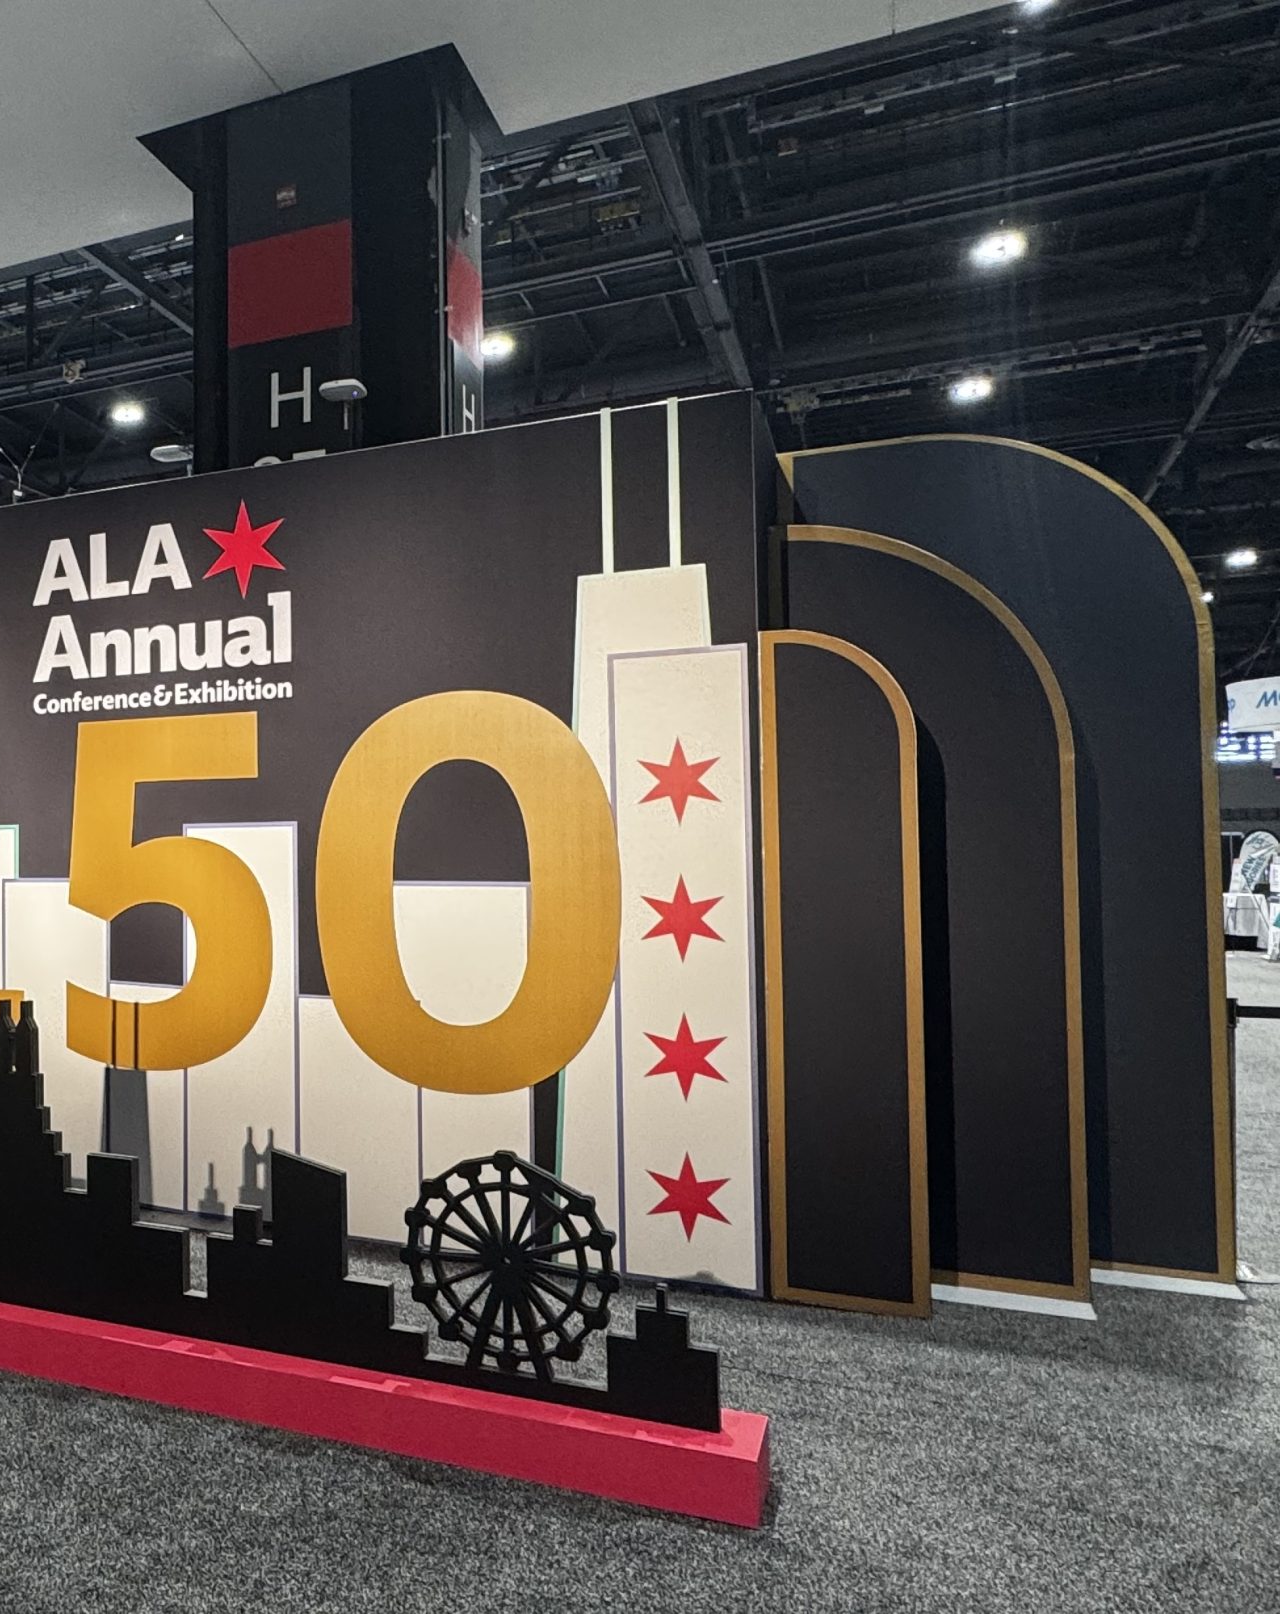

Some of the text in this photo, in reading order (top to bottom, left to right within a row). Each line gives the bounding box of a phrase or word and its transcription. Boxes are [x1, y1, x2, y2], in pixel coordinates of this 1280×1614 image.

[271, 366, 312, 429] H
[463, 384, 476, 433] H
[32, 522, 193, 607] ALA
[32, 590, 293, 684] Annual
[32, 690, 152, 716] Conference
[174, 678, 293, 706] Exhibition
[1256, 690, 1280, 709] M
